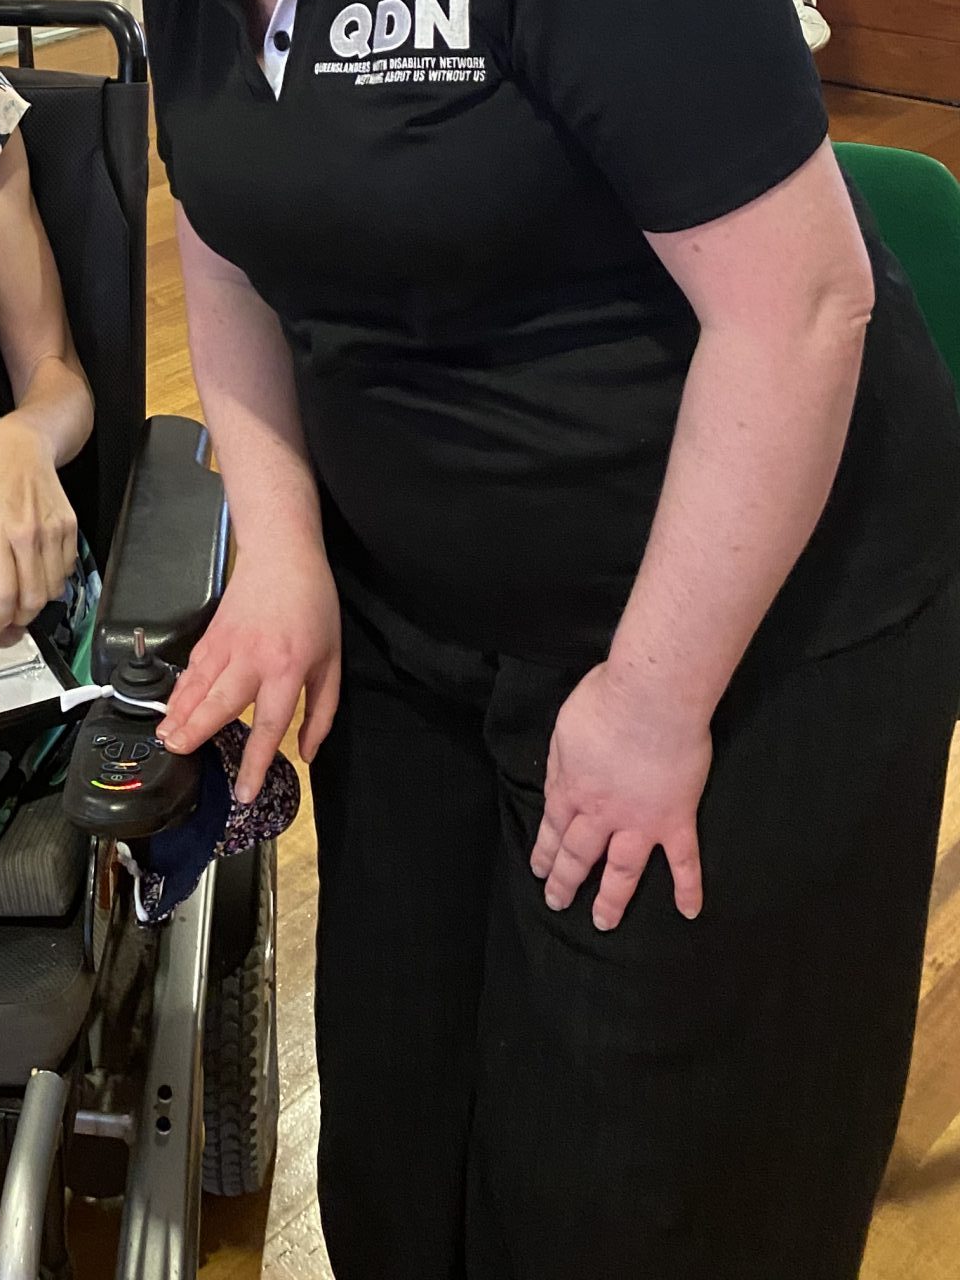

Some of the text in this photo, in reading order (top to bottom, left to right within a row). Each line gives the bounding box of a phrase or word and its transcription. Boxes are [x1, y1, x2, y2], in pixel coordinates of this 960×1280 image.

[314, 61, 371, 75] QUEENSLANDERS
[389, 56, 436, 69] DISABILITY
[439, 56, 485, 69] NETWORK
[384, 70, 412, 83] ABOUT
[413, 70, 425, 82] US
[428, 70, 471, 82] WITHOUT
[473, 70, 486, 82] US
